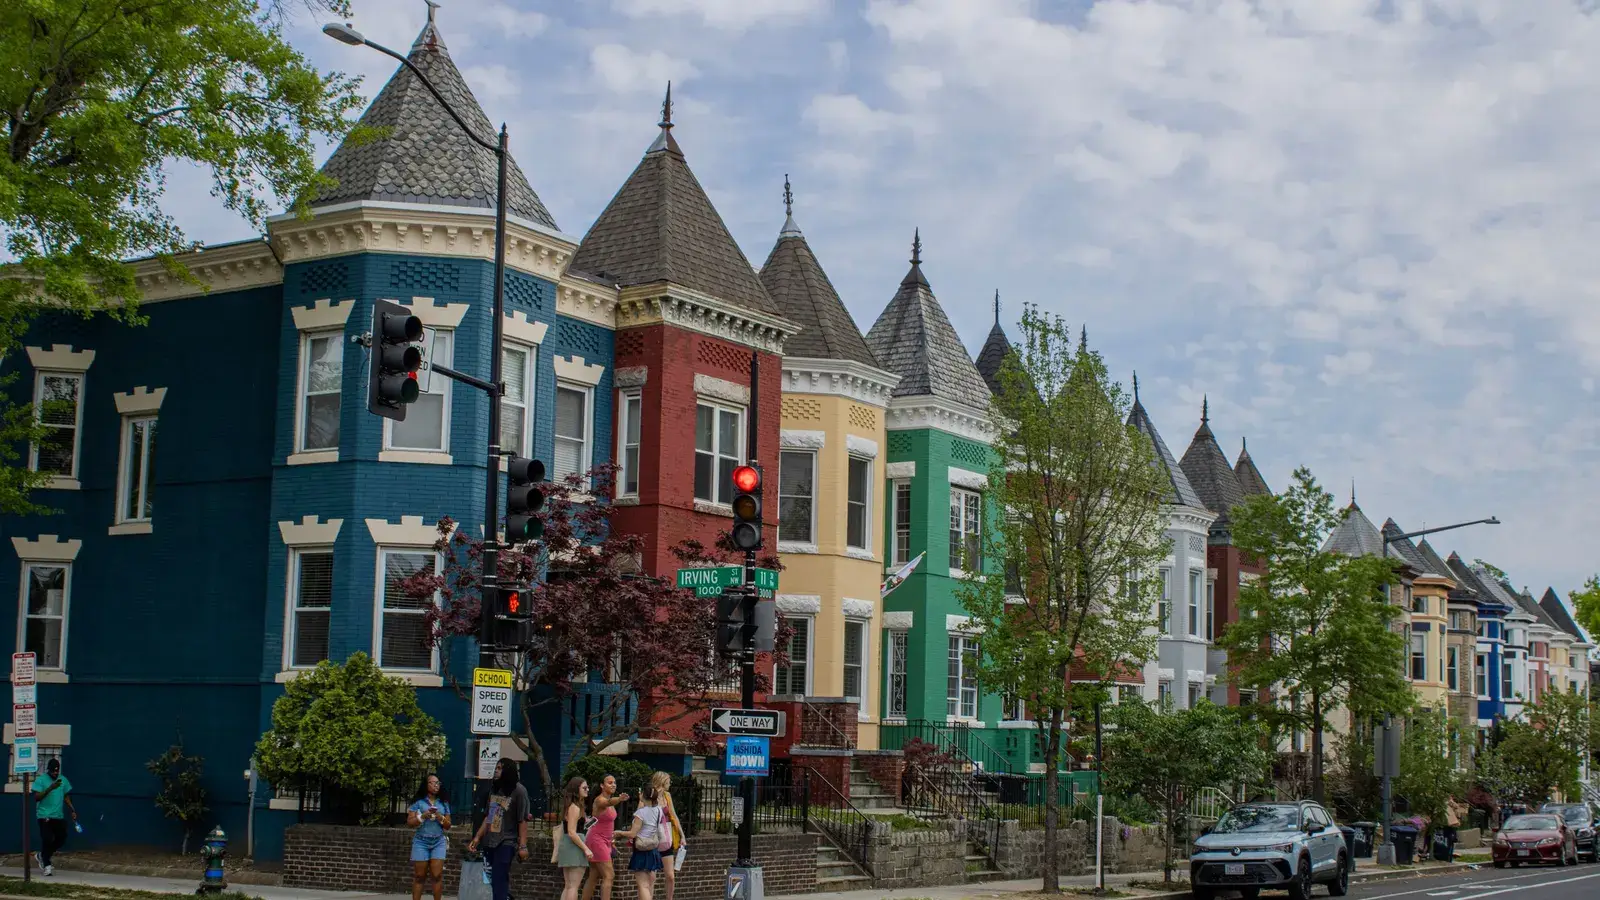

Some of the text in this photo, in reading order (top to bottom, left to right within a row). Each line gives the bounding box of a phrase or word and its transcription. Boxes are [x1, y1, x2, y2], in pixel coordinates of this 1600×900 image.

[731, 568, 738, 576] ST
[681, 570, 718, 585] IRVING
[760, 571, 767, 585] 11
[698, 586, 722, 595] 1000
[759, 588, 772, 598] 3000
[478, 673, 508, 685] SCHOOL
[479, 690, 507, 701] SPEED
[481, 704, 503, 714] ZONE
[477, 718, 506, 728] AHEAD
[730, 717, 771, 728] ONE WAY
[733, 745, 763, 755] RASHIDA
[730, 755, 765, 767] BROWN
